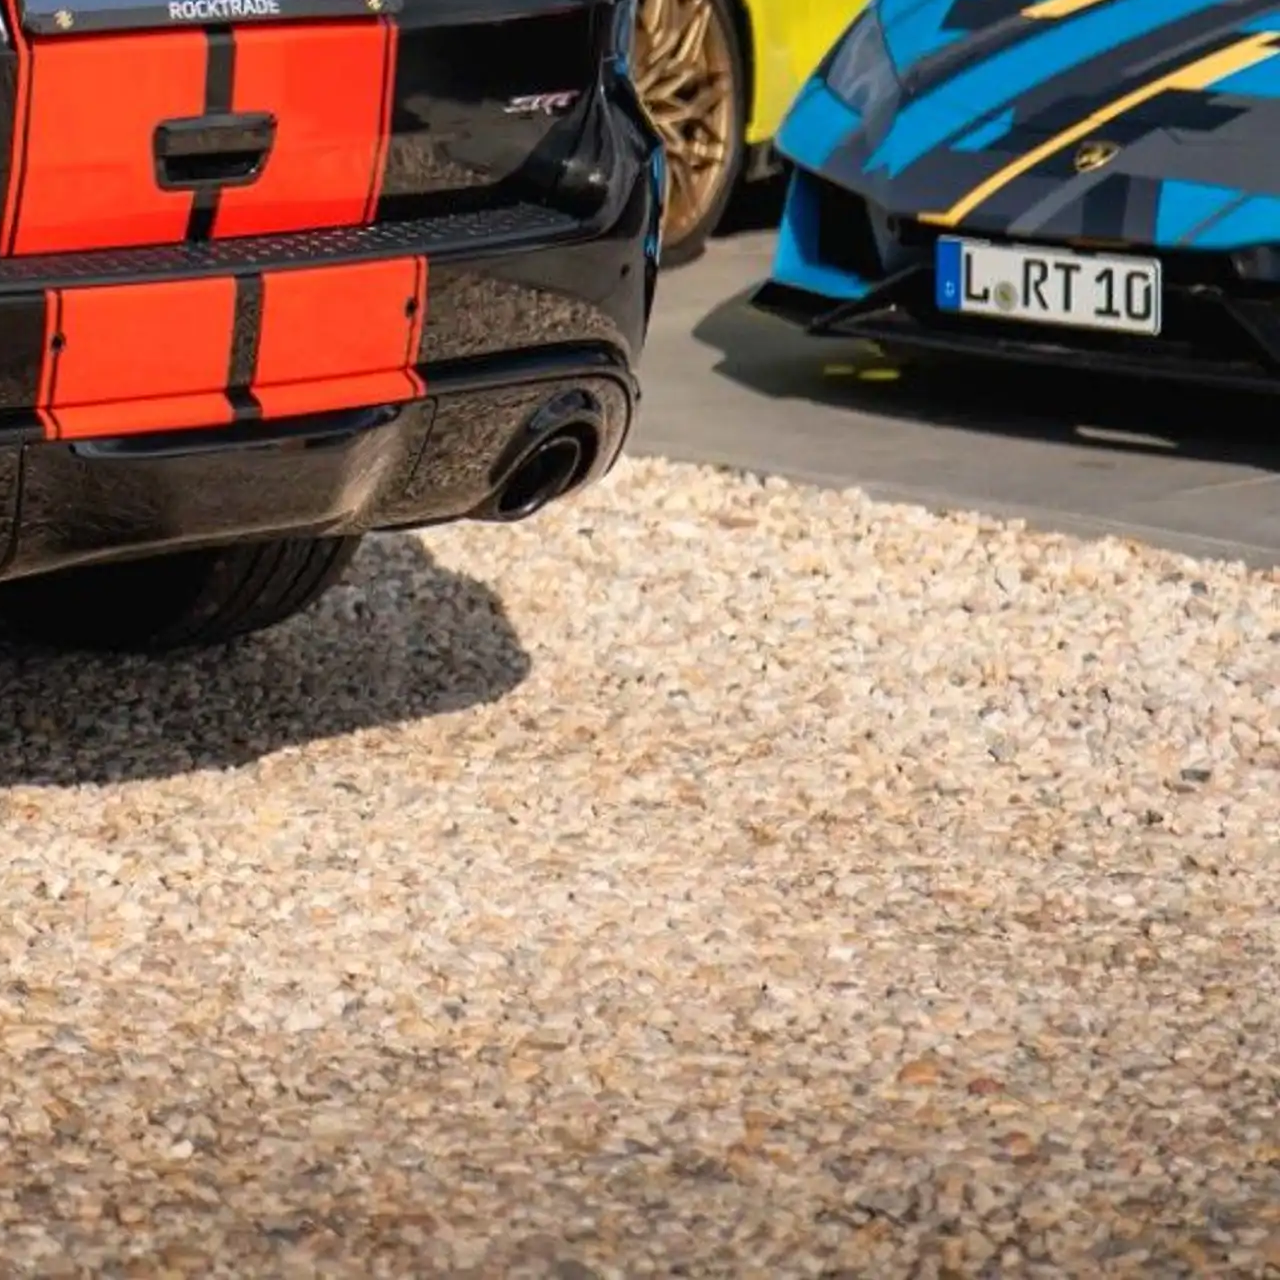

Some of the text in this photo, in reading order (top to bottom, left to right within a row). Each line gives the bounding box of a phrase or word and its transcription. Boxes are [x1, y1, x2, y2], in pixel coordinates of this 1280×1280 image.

[965, 253, 1152, 320] L RT 10
